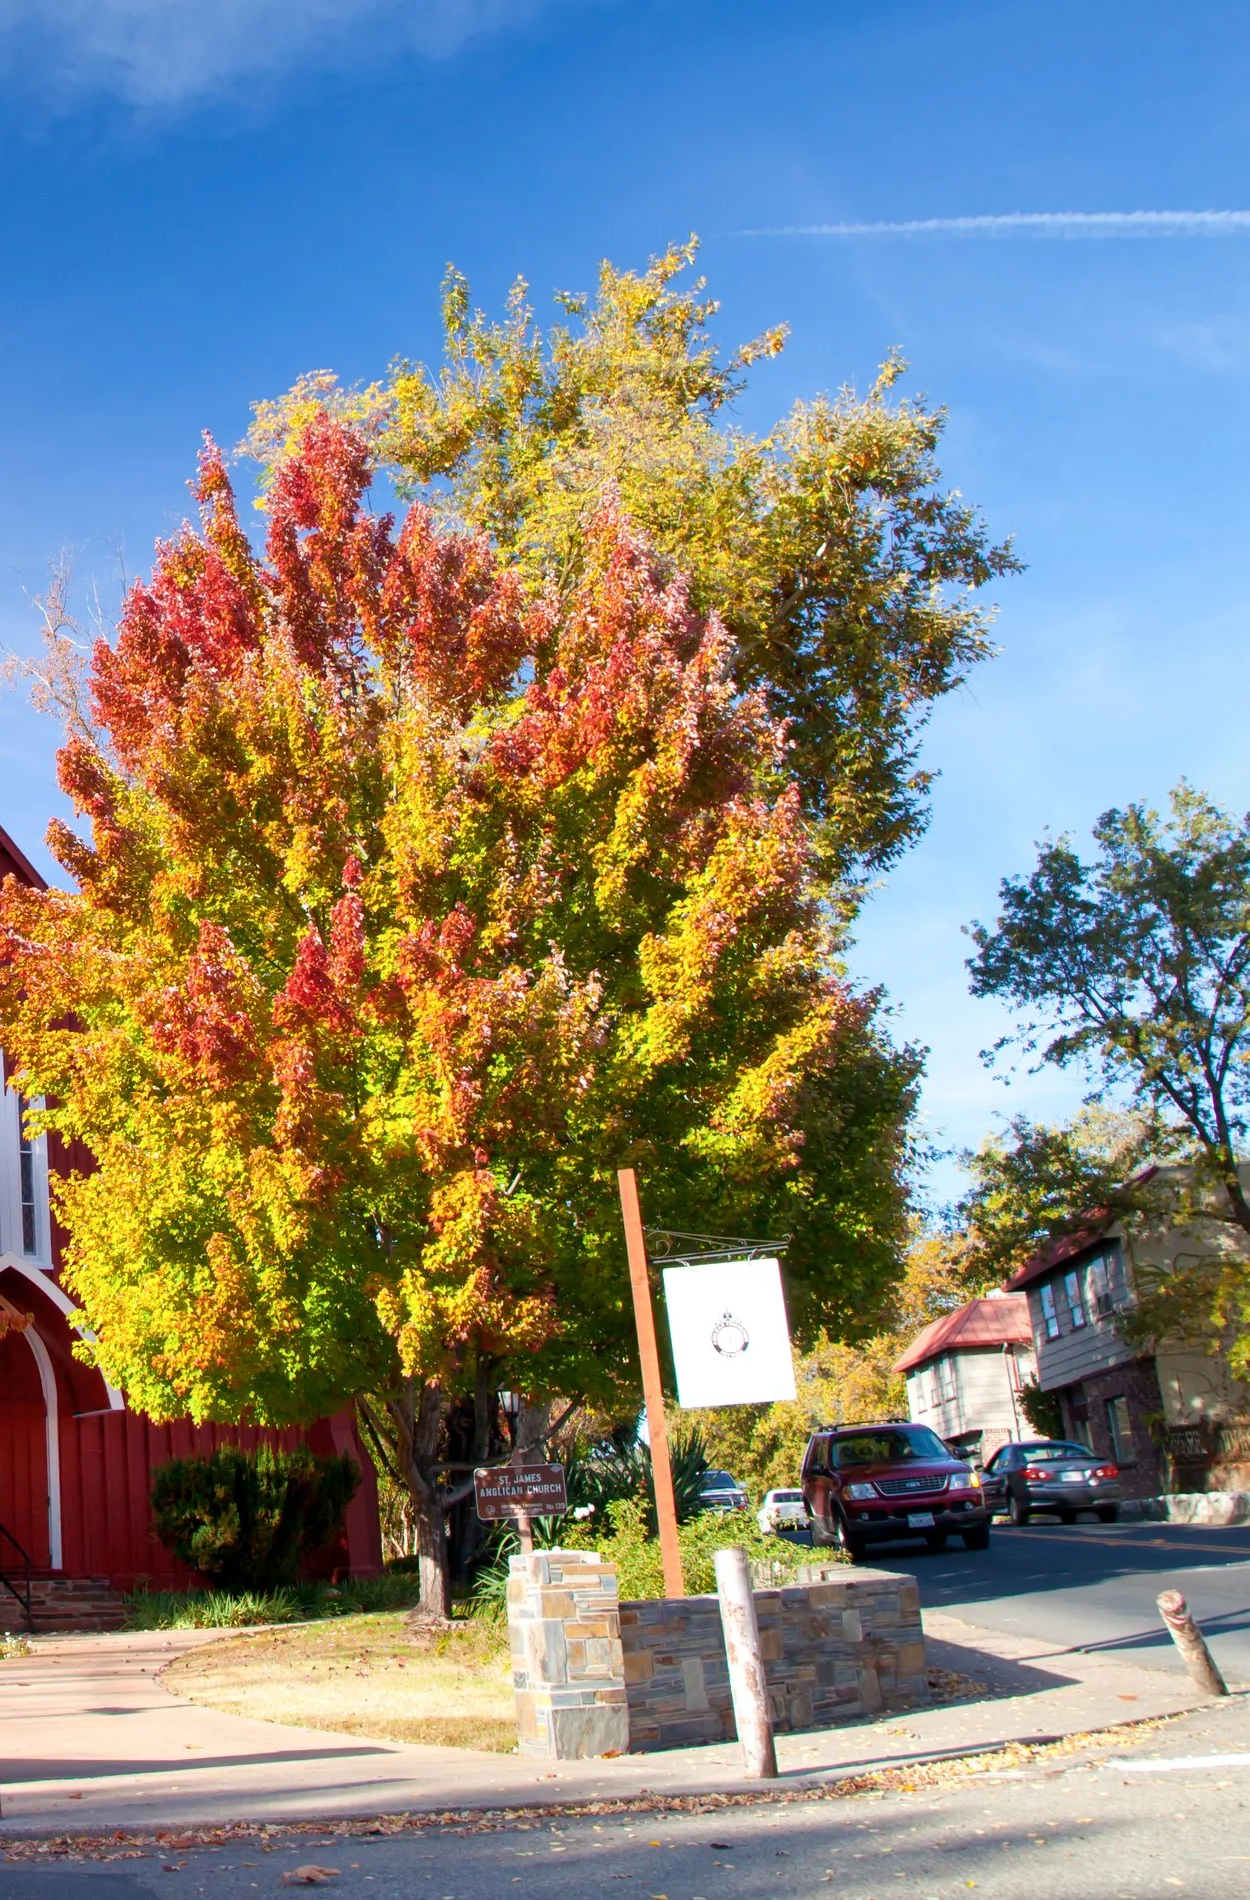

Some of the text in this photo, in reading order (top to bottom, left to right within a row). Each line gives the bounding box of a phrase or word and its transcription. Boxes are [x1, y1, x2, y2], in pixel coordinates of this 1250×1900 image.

[513, 1473, 542, 1484] JAMES
[480, 1483, 562, 1497] ANGLICAN CHURCH
